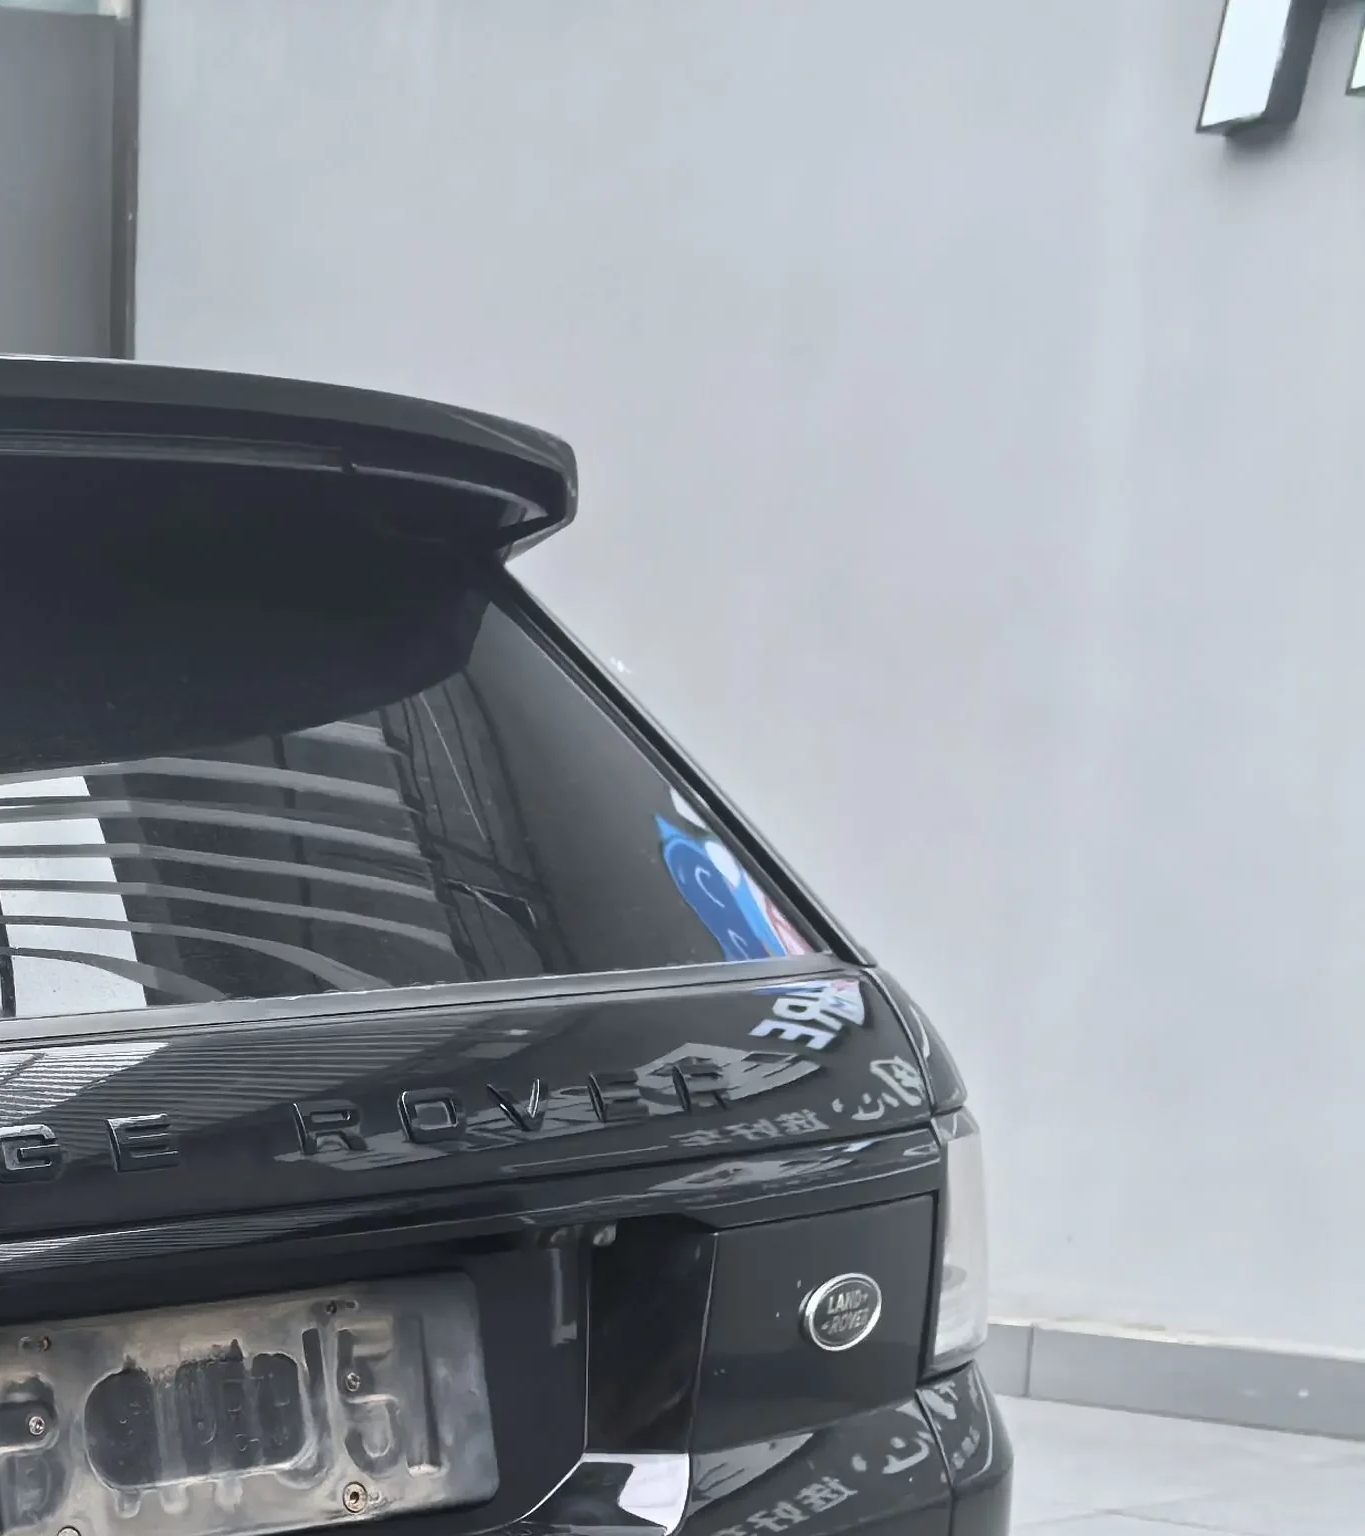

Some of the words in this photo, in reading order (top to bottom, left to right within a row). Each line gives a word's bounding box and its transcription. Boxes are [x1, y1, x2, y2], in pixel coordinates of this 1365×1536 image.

[292, 1062, 731, 1155] ROVER
[827, 1289, 862, 1315] LAND
[828, 1307, 870, 1335] ROVER
